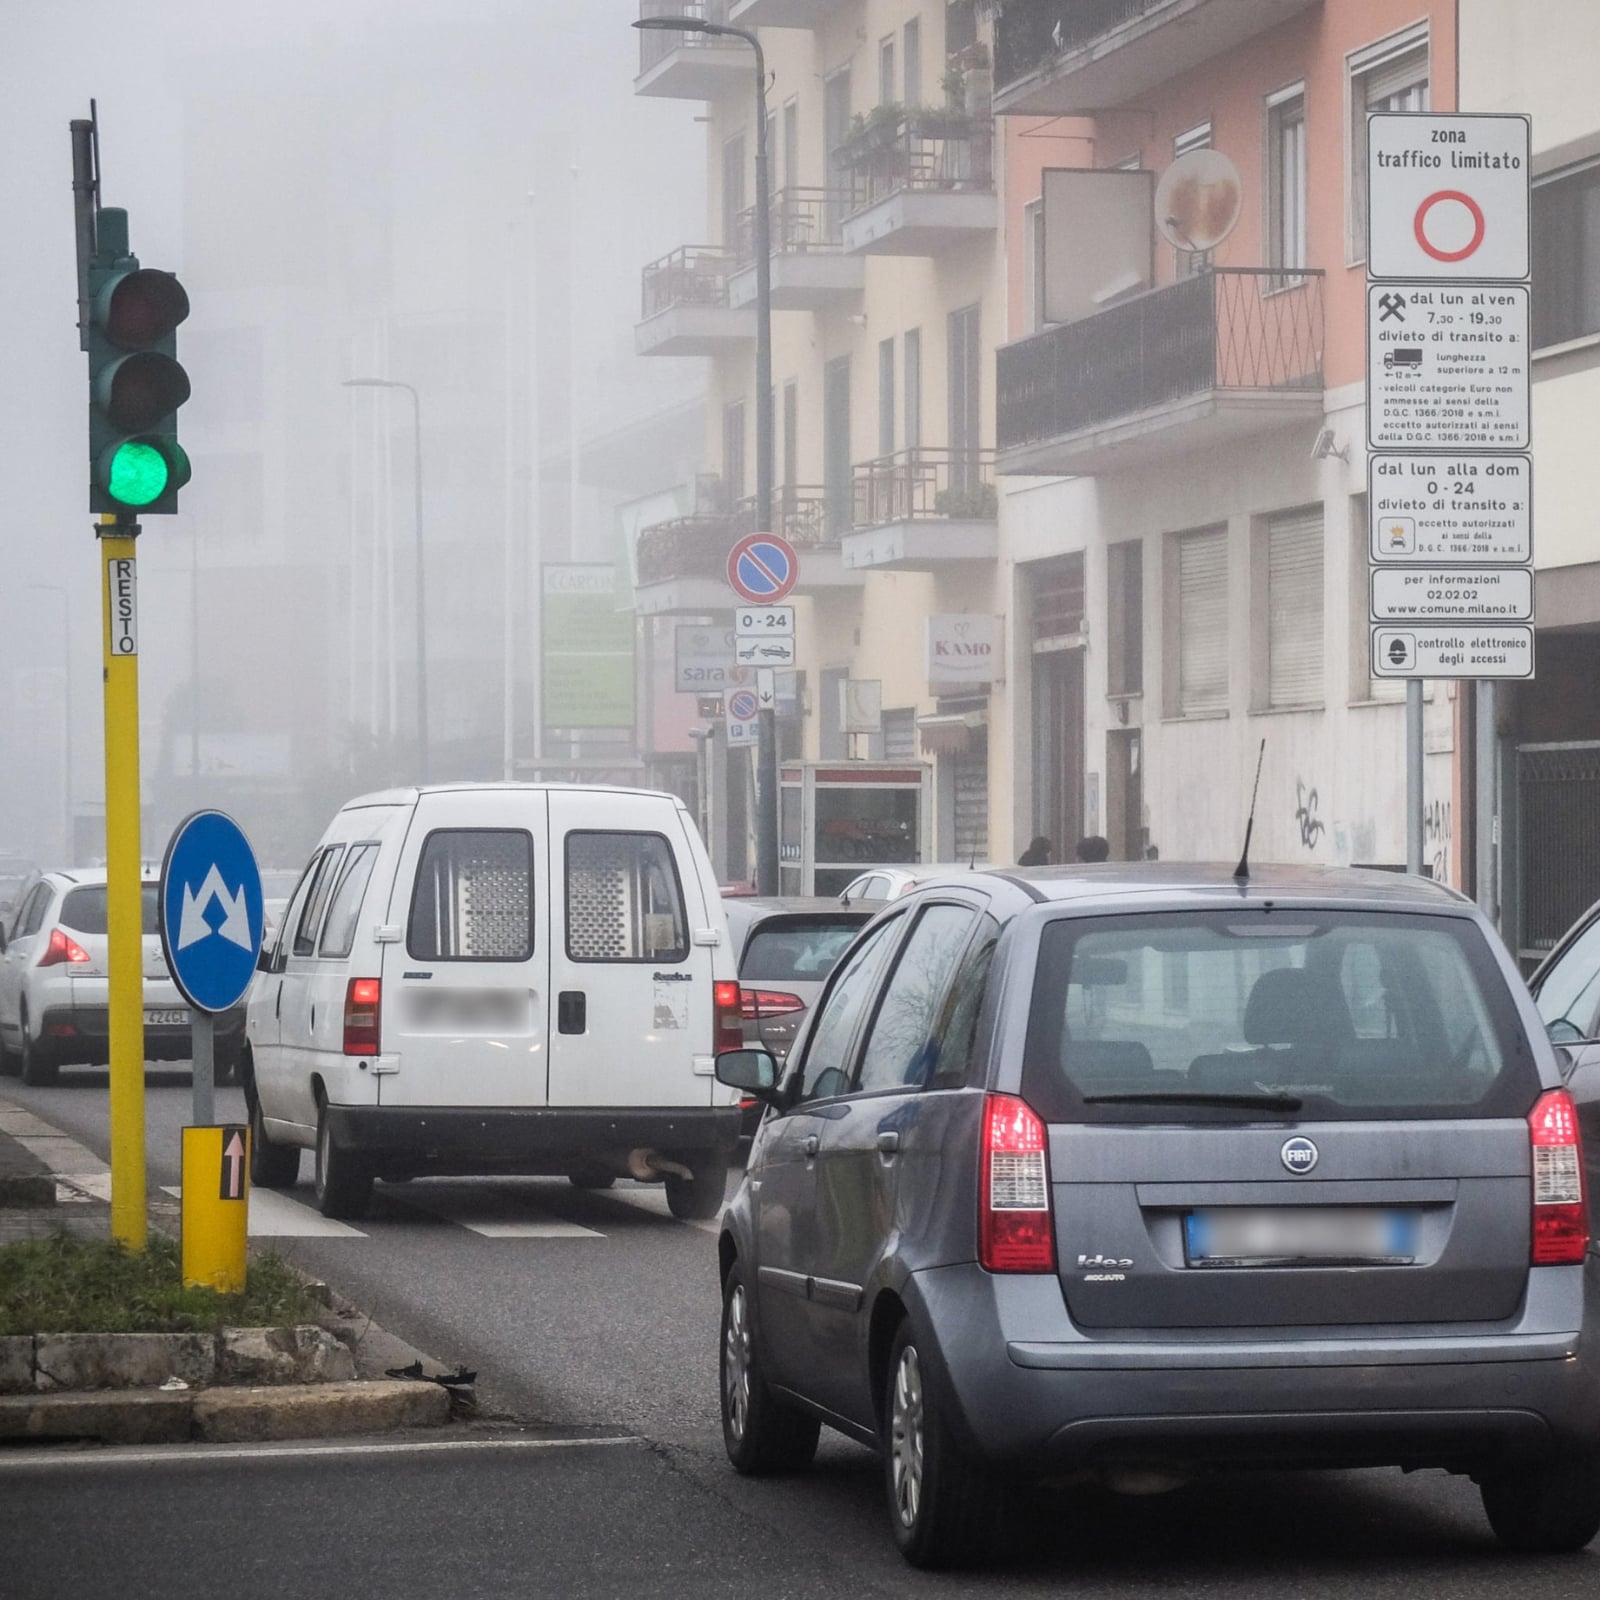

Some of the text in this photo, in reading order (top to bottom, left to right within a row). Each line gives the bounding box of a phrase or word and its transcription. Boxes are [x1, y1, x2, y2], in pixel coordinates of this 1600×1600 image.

[1432, 130, 1466, 143] zona
[1377, 150, 1520, 169] traffico limitato
[1410, 293, 1516, 306] dal lun al ven
[1379, 331, 1520, 343] divieto di transito a:
[1437, 353, 1485, 363] lunghezza
[1436, 366, 1521, 375] superiore a 12 m
[1383, 384, 1417, 393] veicoli
[1419, 384, 1467, 394] categorie
[1469, 385, 1492, 393] Euro
[1383, 398, 1430, 406] ammesse
[1445, 398, 1471, 406] sensi
[1474, 398, 1500, 406] della
[1383, 421, 1422, 430] eccetto
[1425, 422, 1478, 430] autorizzati
[1493, 422, 1519, 430] sensi
[1377, 433, 1403, 441] della
[1378, 463, 1519, 476] dal lun alla dom
[1454, 482, 1474, 494] 24
[1378, 499, 1524, 511] divieto di transito a:
[1418, 520, 1516, 529] eccetto autorizzati
[1404, 575, 1501, 586] per informazioni
[1426, 590, 1478, 600] 02.02.02
[117, 561, 134, 653] RESTO
[1387, 604, 1518, 614] www.comune.milano.it
[766, 615, 786, 627] 24
[935, 640, 992, 656] KAMO
[1418, 638, 1526, 648] controllo elettronico
[1439, 653, 1507, 666] degli accessi
[682, 666, 725, 681] sara
[1287, 1149, 1312, 1162] FIAT
[1077, 1254, 1134, 1269] Idea
